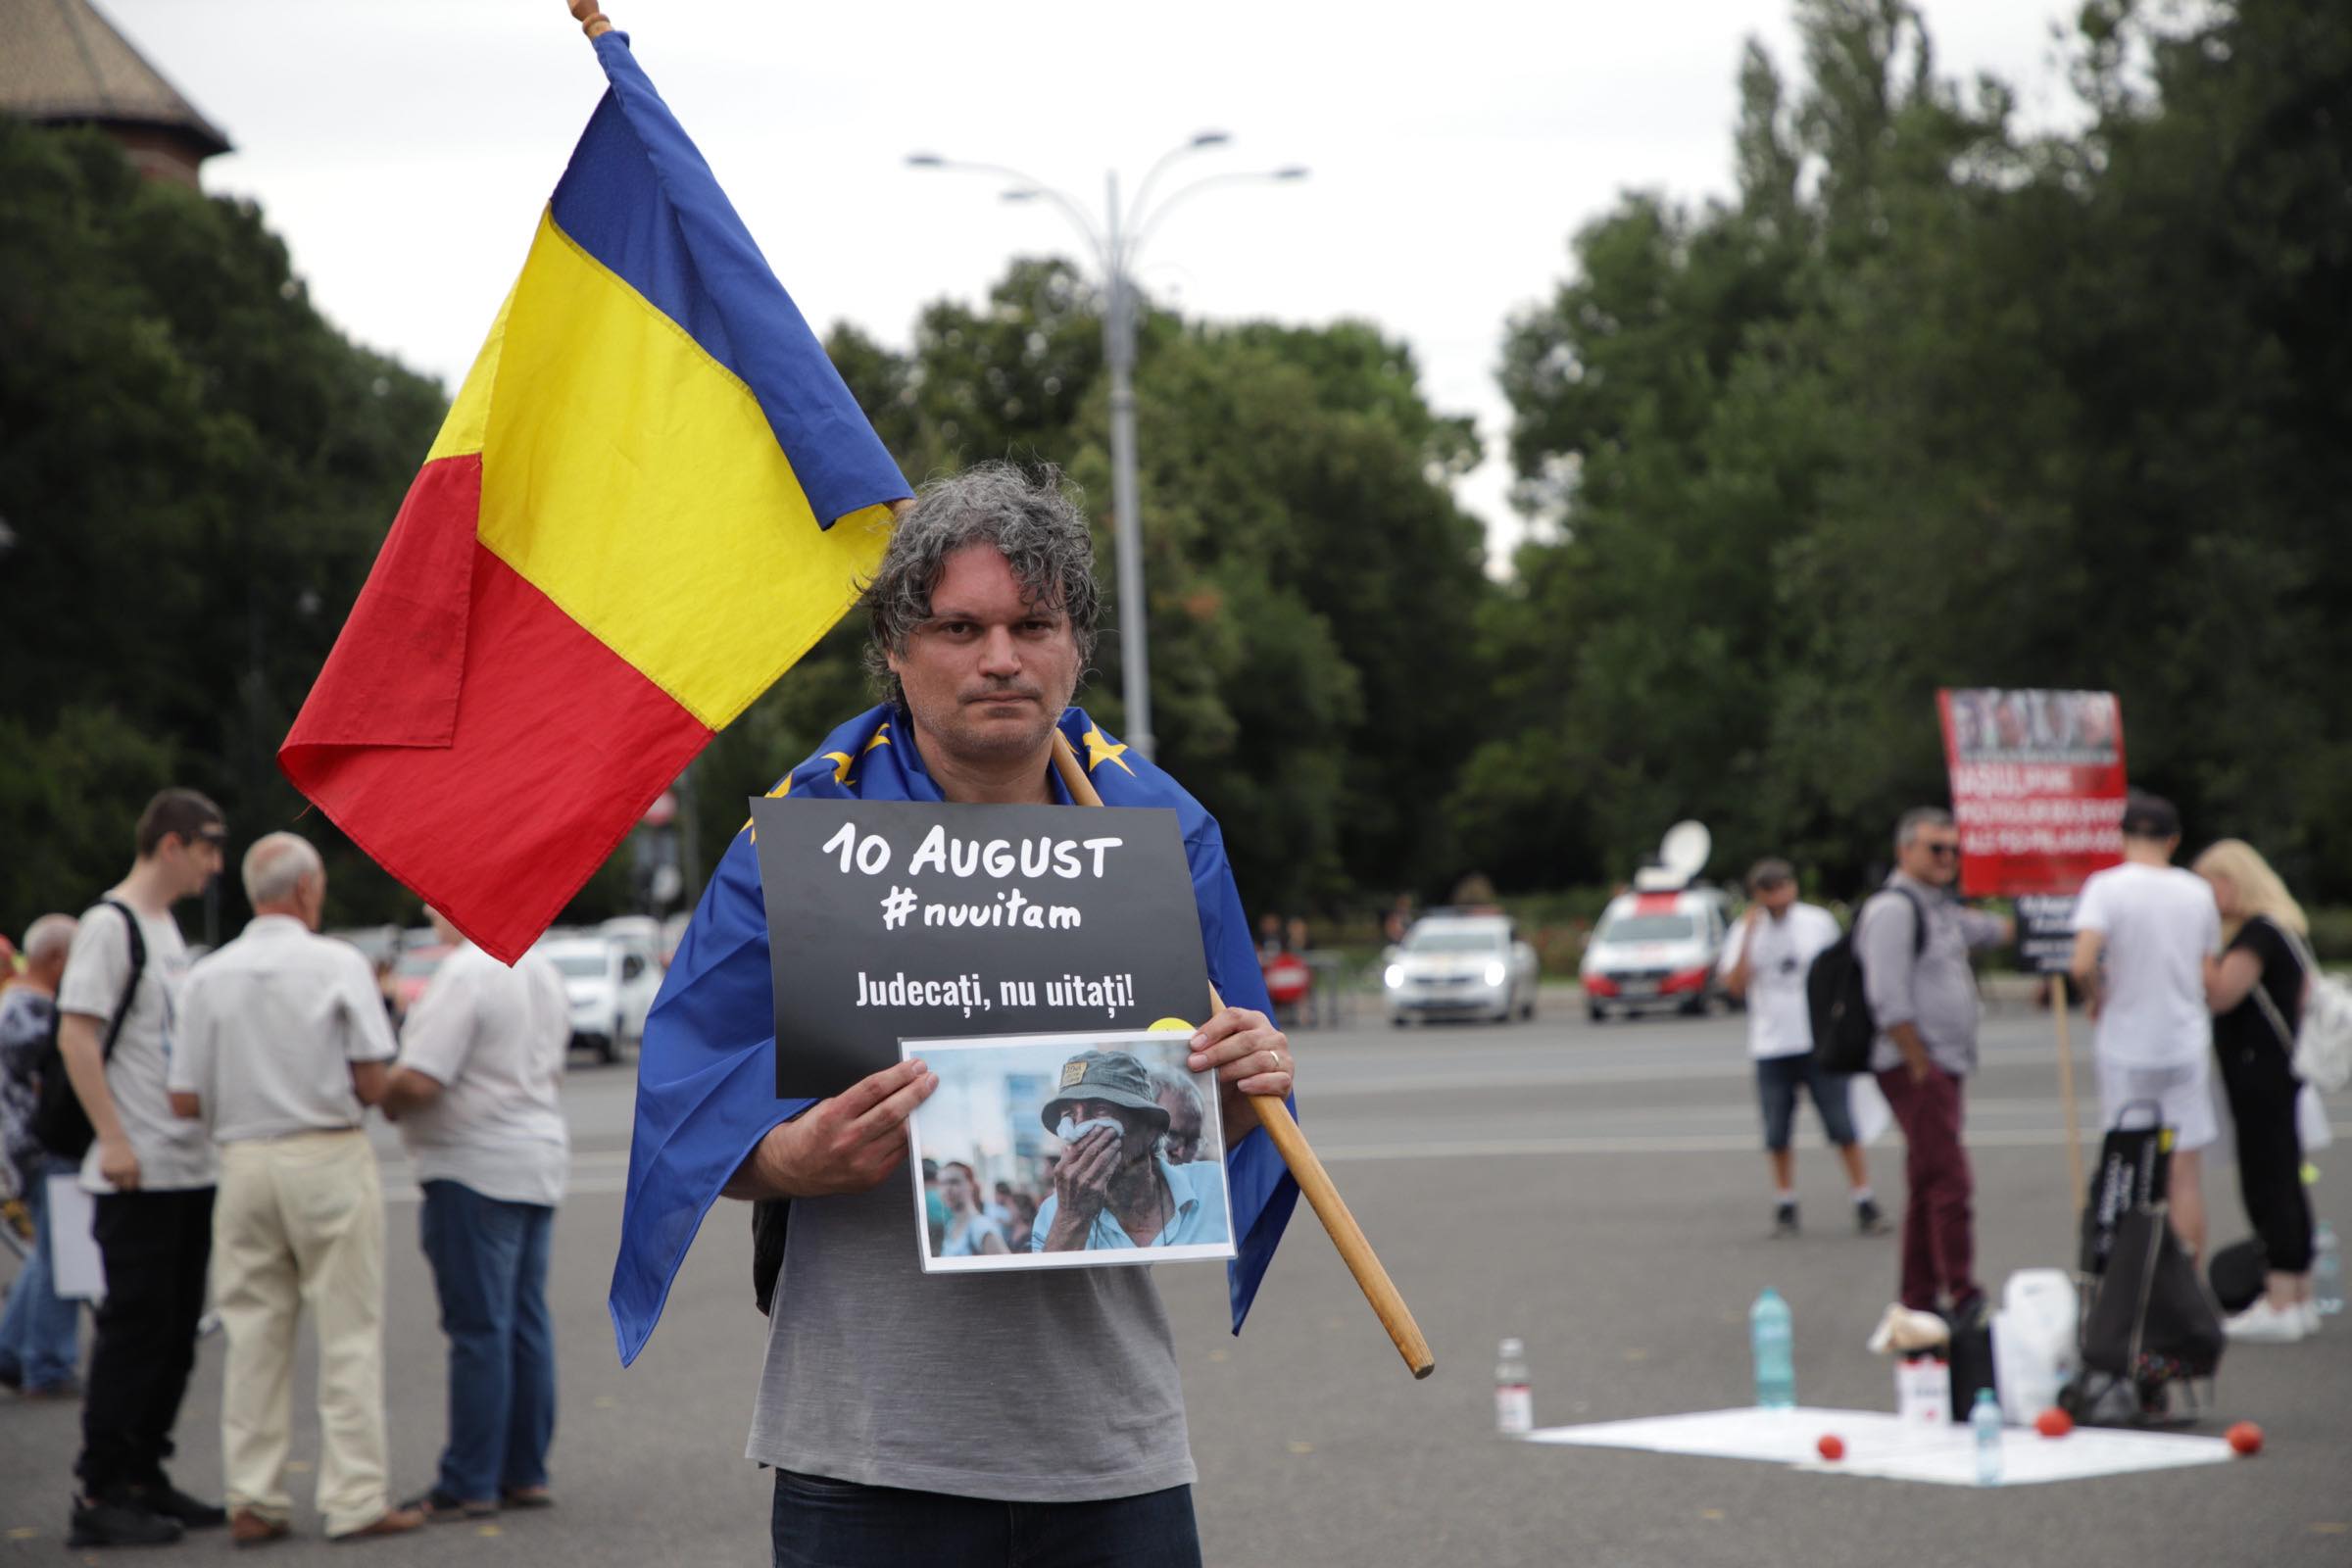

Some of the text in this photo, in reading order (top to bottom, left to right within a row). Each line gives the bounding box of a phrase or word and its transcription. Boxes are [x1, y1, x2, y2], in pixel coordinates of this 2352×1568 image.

[822, 821, 1124, 880] 10 AUGUST
[879, 885, 1082, 931] #nuuitam
[856, 971, 1135, 1019] Judecați, nu uitați!
